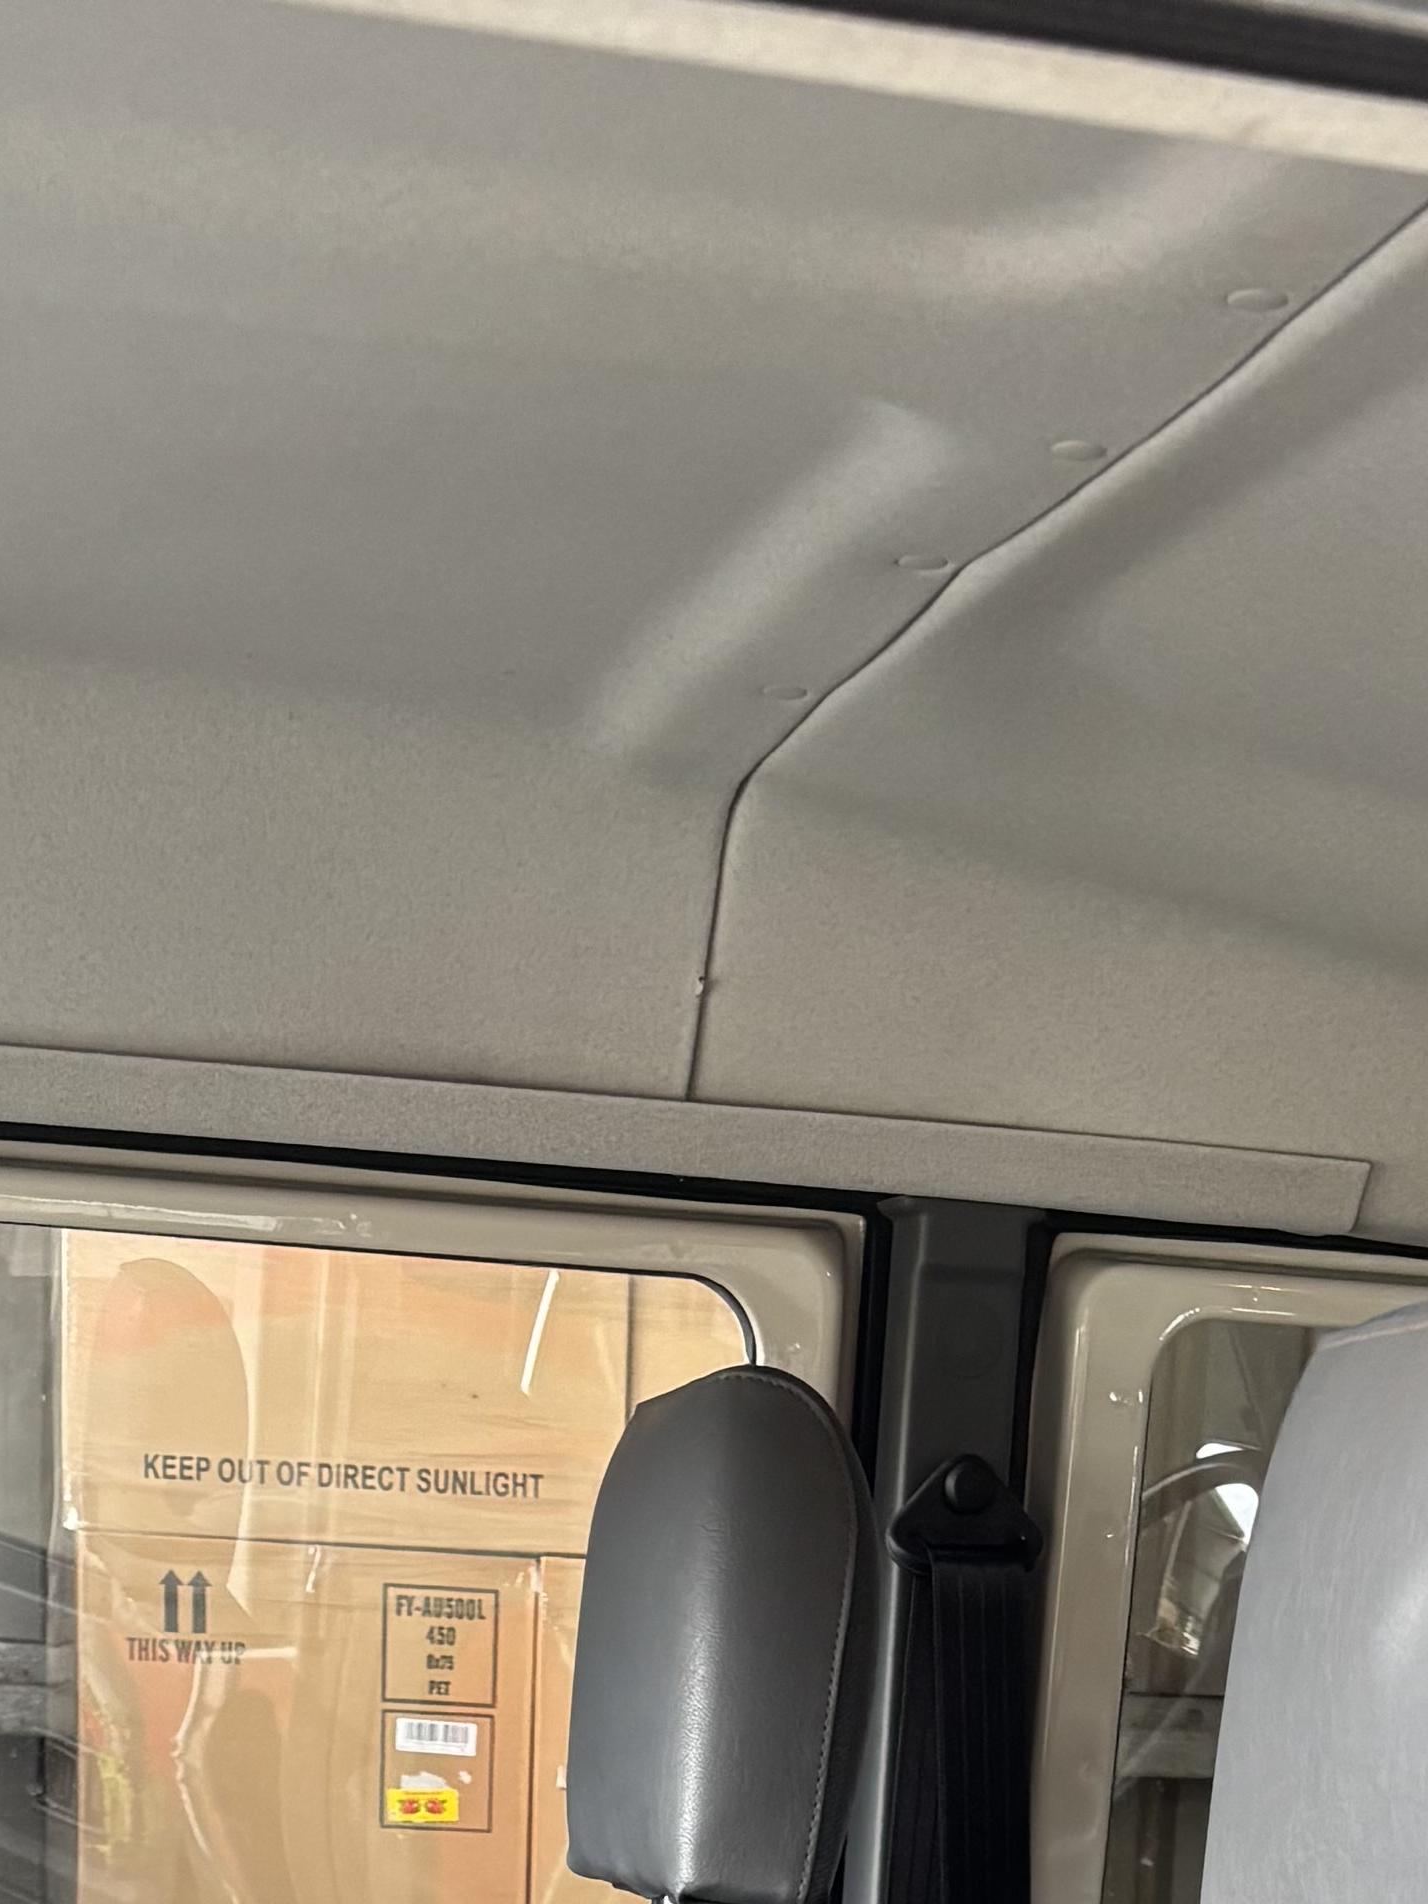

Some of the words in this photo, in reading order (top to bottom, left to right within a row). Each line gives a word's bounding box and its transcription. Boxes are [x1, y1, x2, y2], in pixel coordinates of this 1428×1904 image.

[143, 1453, 211, 1482] KEEP
[217, 1457, 271, 1485] OUT
[276, 1460, 311, 1487] OF
[317, 1463, 410, 1492] DIRECT
[416, 1467, 545, 1499] SUNLIGHT
[426, 1625, 457, 1646] 450
[126, 1637, 170, 1662] THIS
[174, 1639, 215, 1665] WAY
[219, 1641, 246, 1665] UP
